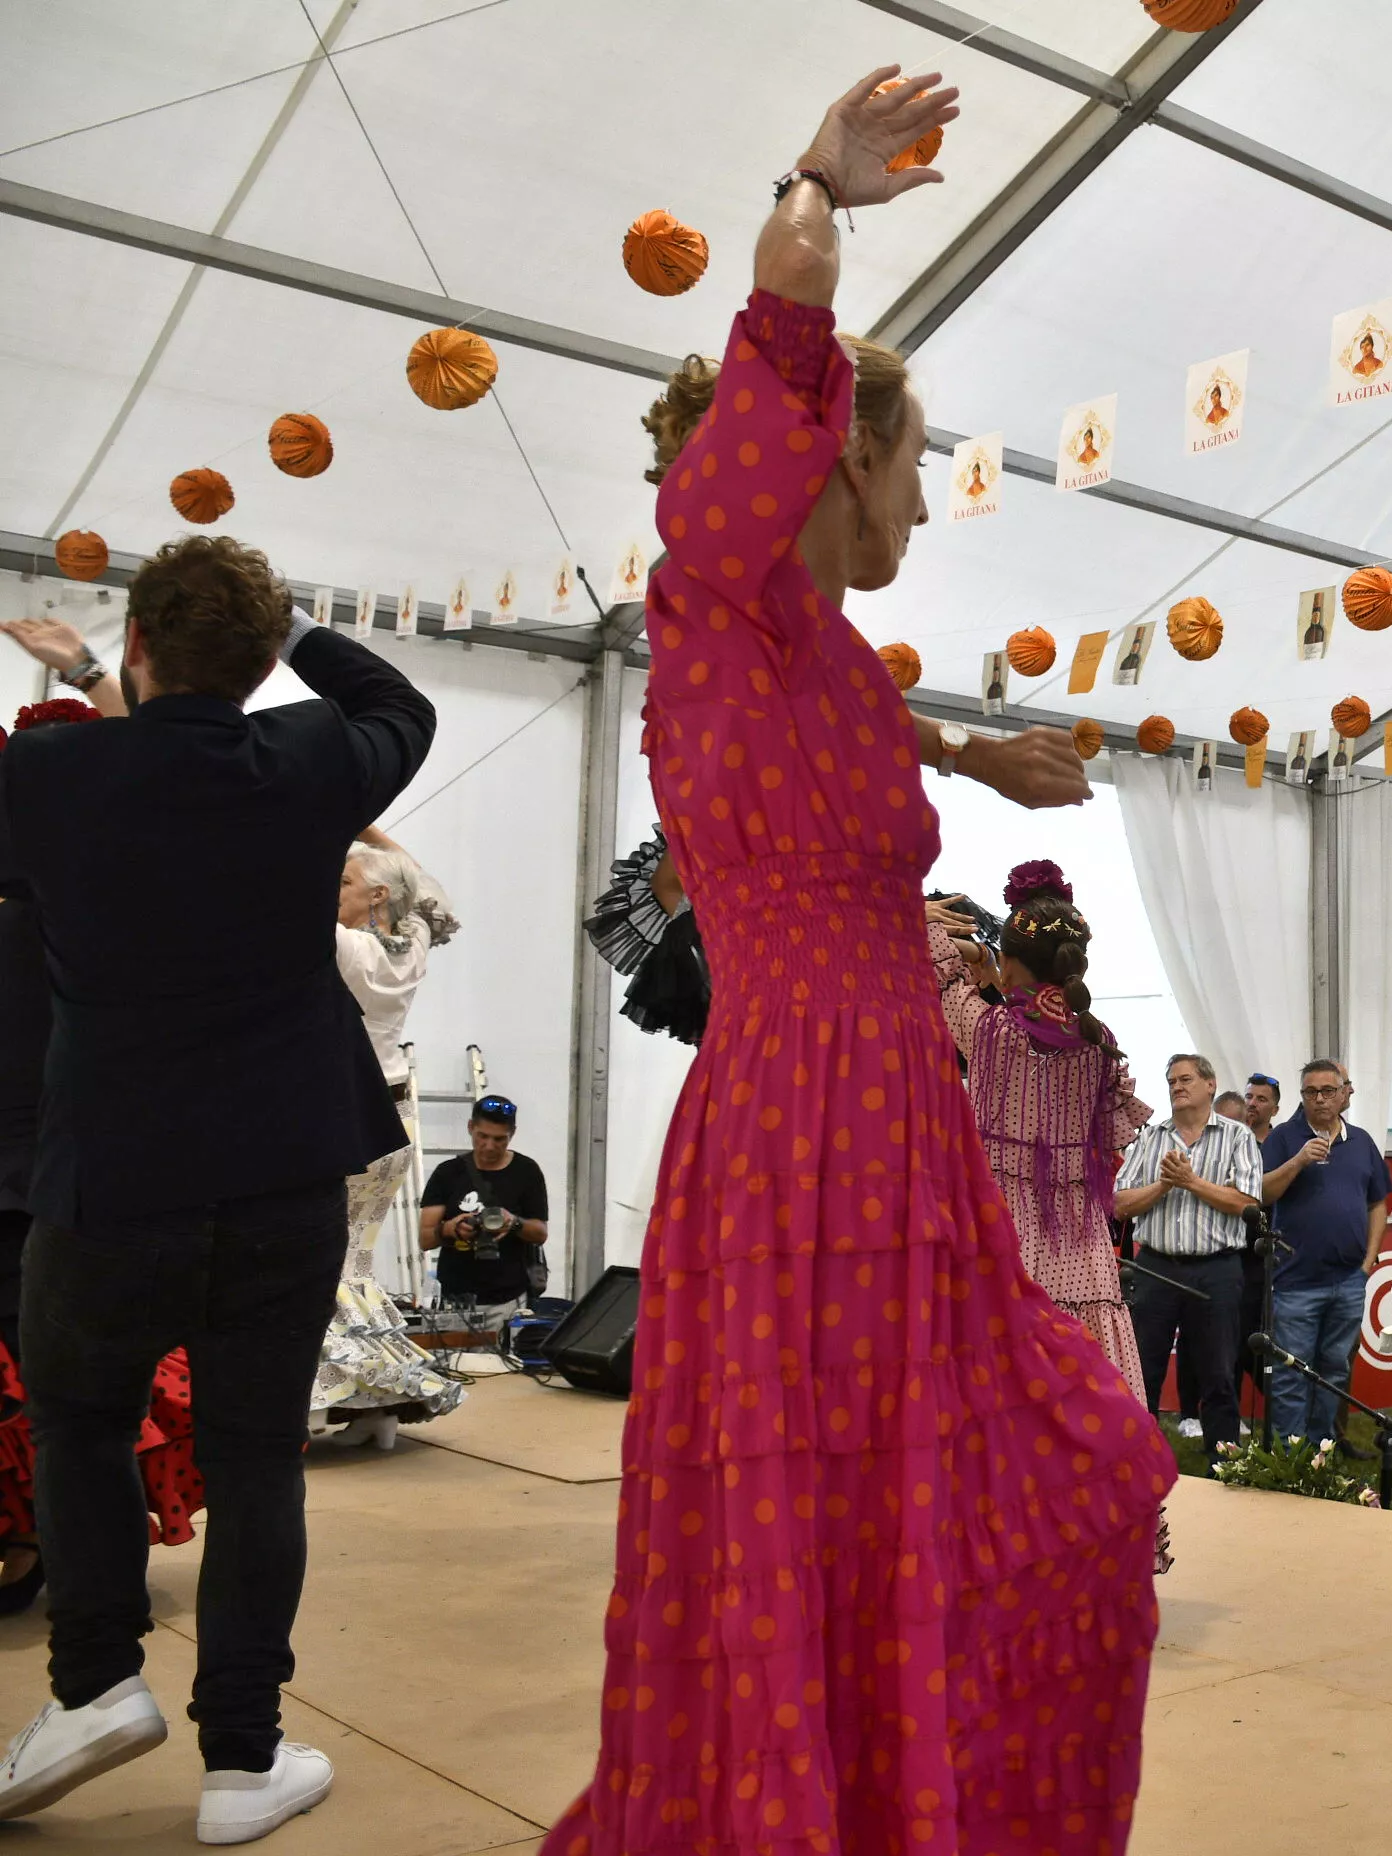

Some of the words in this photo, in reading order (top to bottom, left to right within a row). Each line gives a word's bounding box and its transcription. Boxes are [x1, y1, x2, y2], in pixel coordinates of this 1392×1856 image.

[1336, 390, 1352, 405] LA
[1192, 438, 1206, 452] LA
[1207, 428, 1240, 449] GITANA
[1064, 477, 1077, 490] LA
[1078, 469, 1109, 488] GITANA
[954, 510, 965, 520] LA
[966, 503, 997, 518] GITANA
